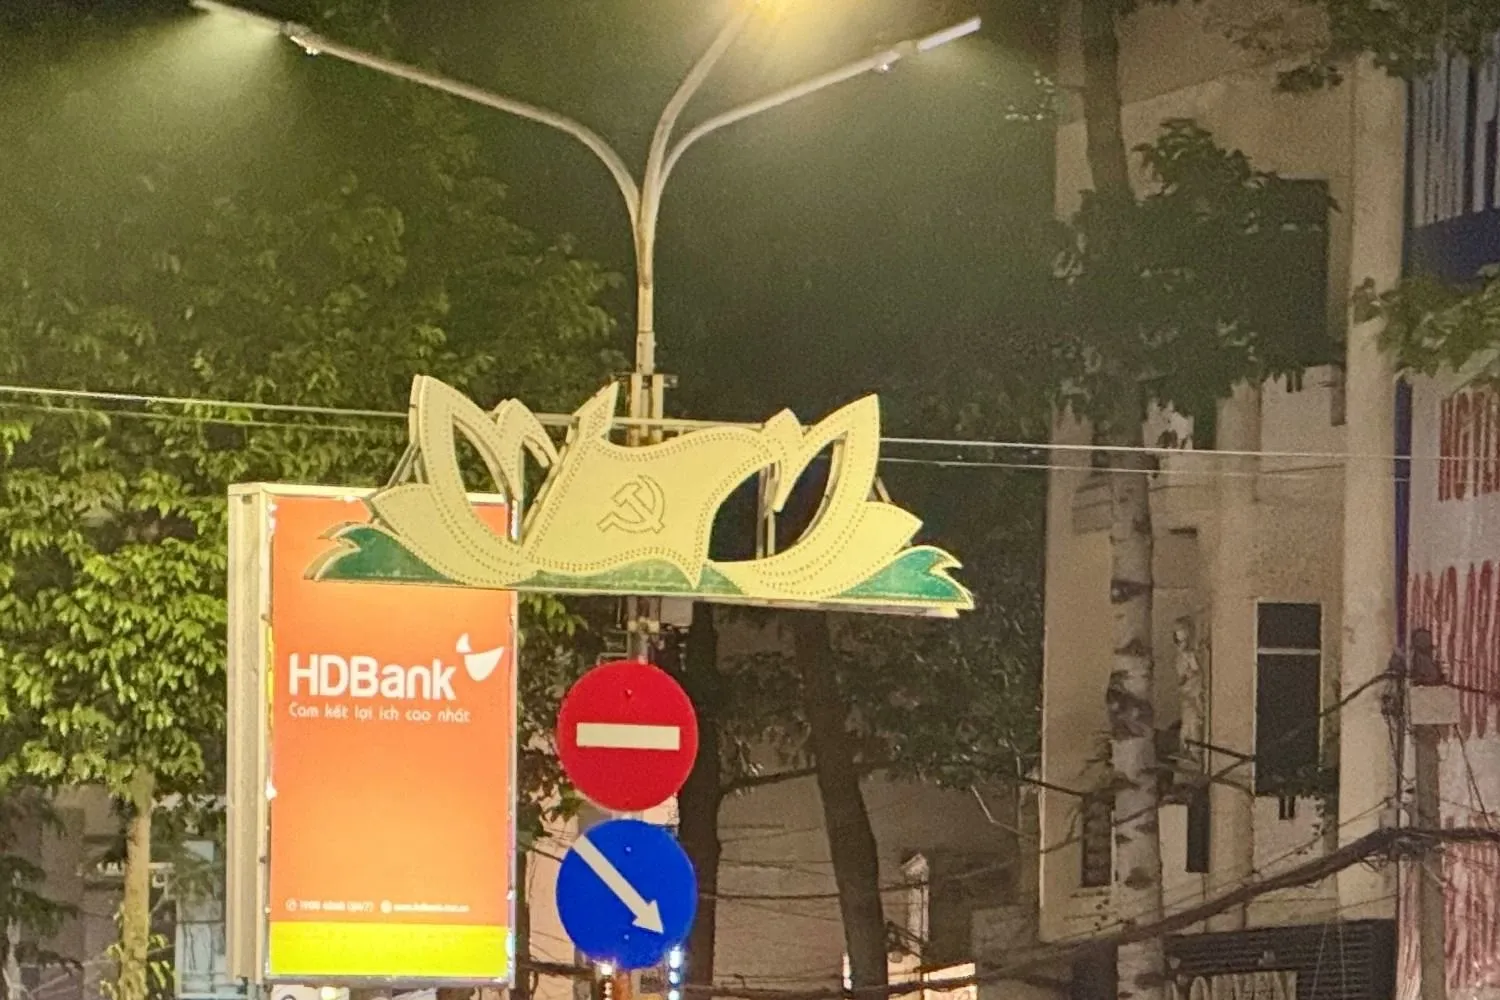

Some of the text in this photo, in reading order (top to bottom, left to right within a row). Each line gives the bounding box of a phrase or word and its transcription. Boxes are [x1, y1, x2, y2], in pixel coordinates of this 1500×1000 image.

[288, 652, 457, 701] HDBank
[289, 702, 319, 718] Cam
[406, 709, 432, 722] cao
